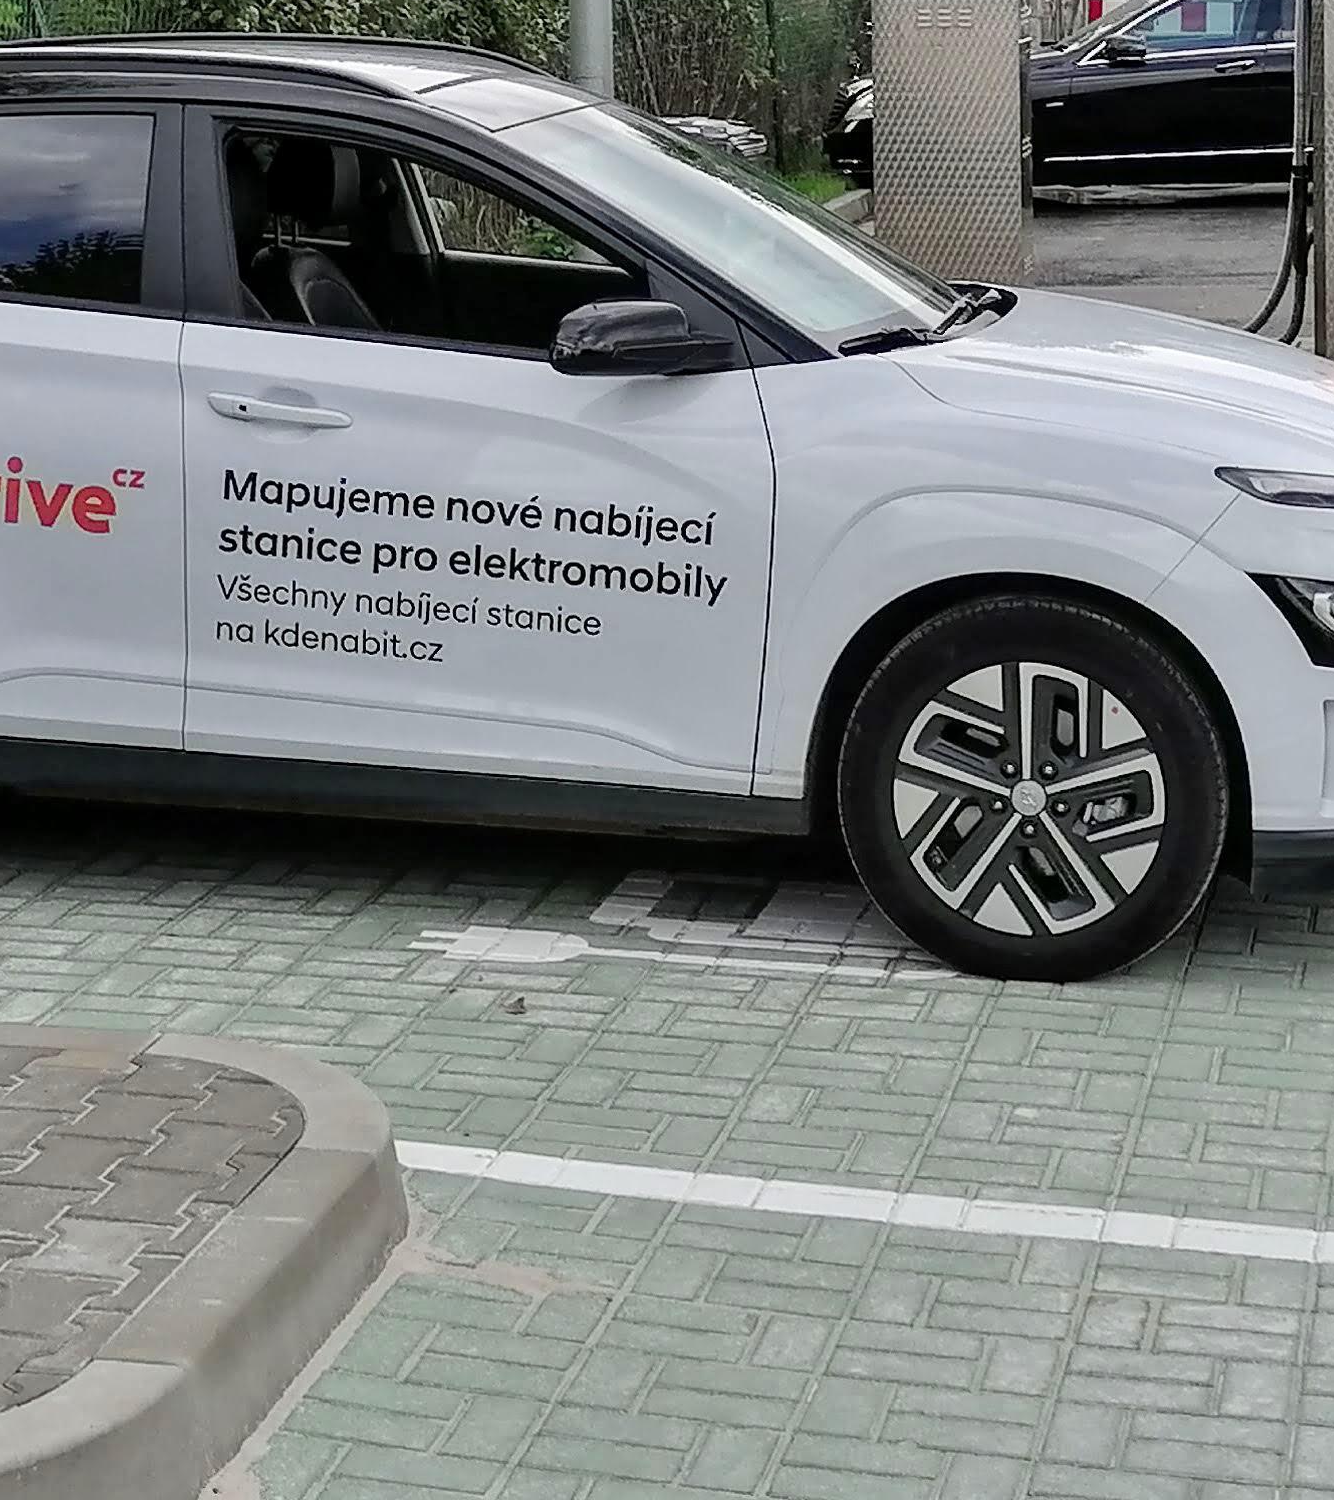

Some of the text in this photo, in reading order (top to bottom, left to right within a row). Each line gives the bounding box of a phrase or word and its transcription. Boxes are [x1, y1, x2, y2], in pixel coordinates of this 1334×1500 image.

[223, 469, 717, 547] Mapujeme nové nabíjecí
[218, 524, 728, 607] stanice pro elektromobily
[217, 573, 602, 636] Všechny nabíjecí stanice
[216, 617, 444, 663] na kdenabit.cz
